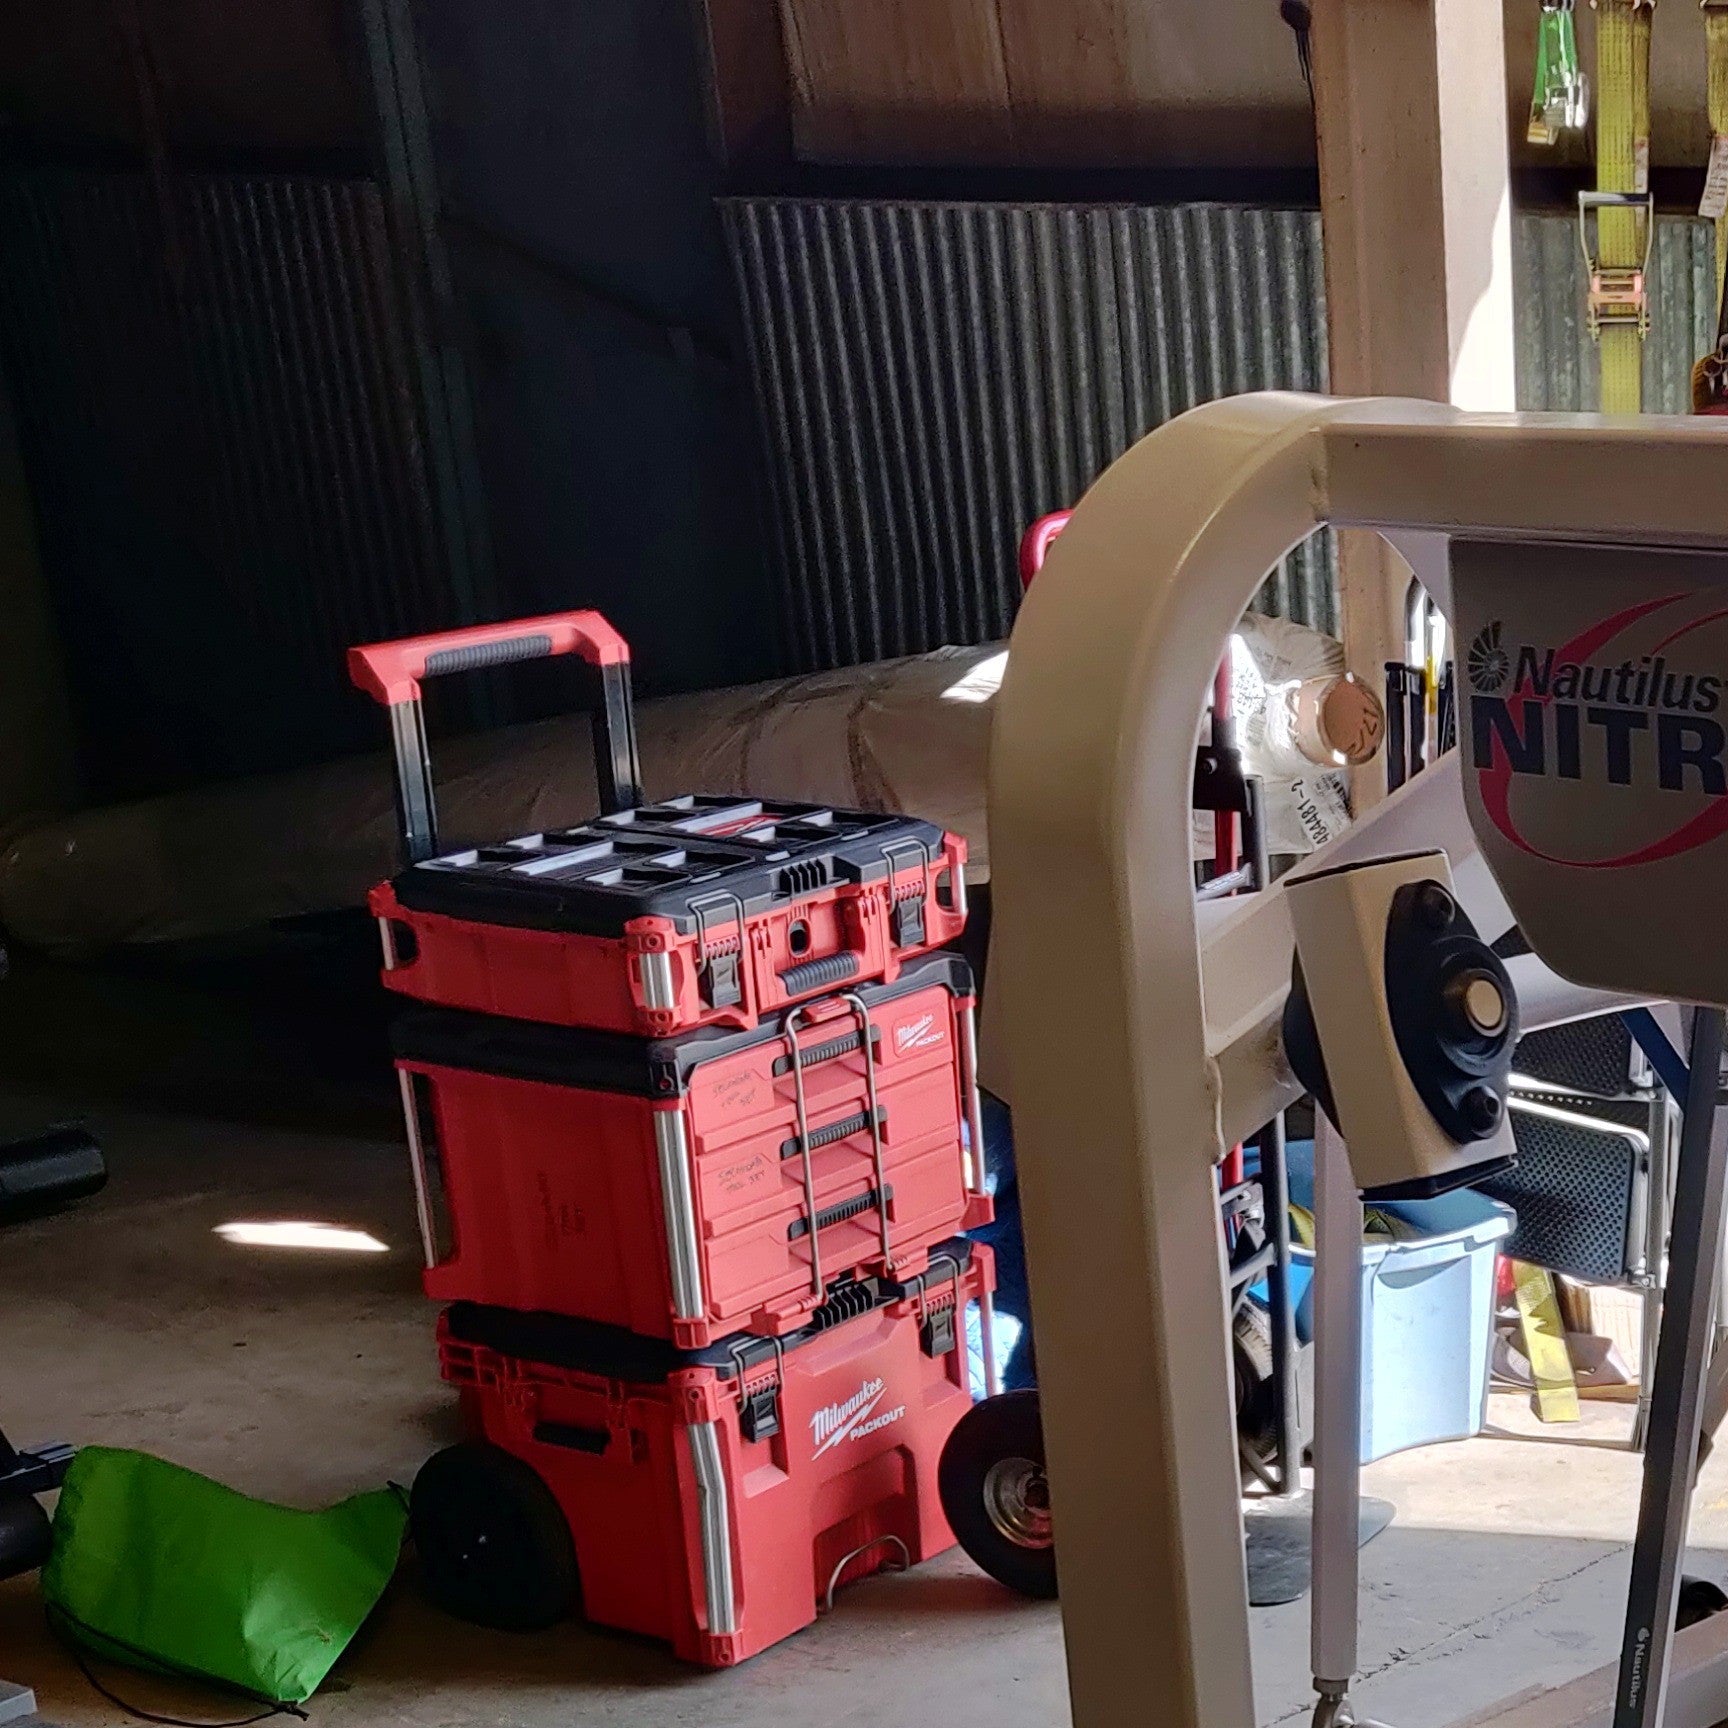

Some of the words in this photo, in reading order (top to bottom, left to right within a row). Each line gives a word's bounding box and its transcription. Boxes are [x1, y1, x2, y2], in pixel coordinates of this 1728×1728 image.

[1514, 645, 1723, 714] Nautilus
[808, 1377, 885, 1447] Milwaukee
[849, 1405, 906, 1442] PACKOUT
